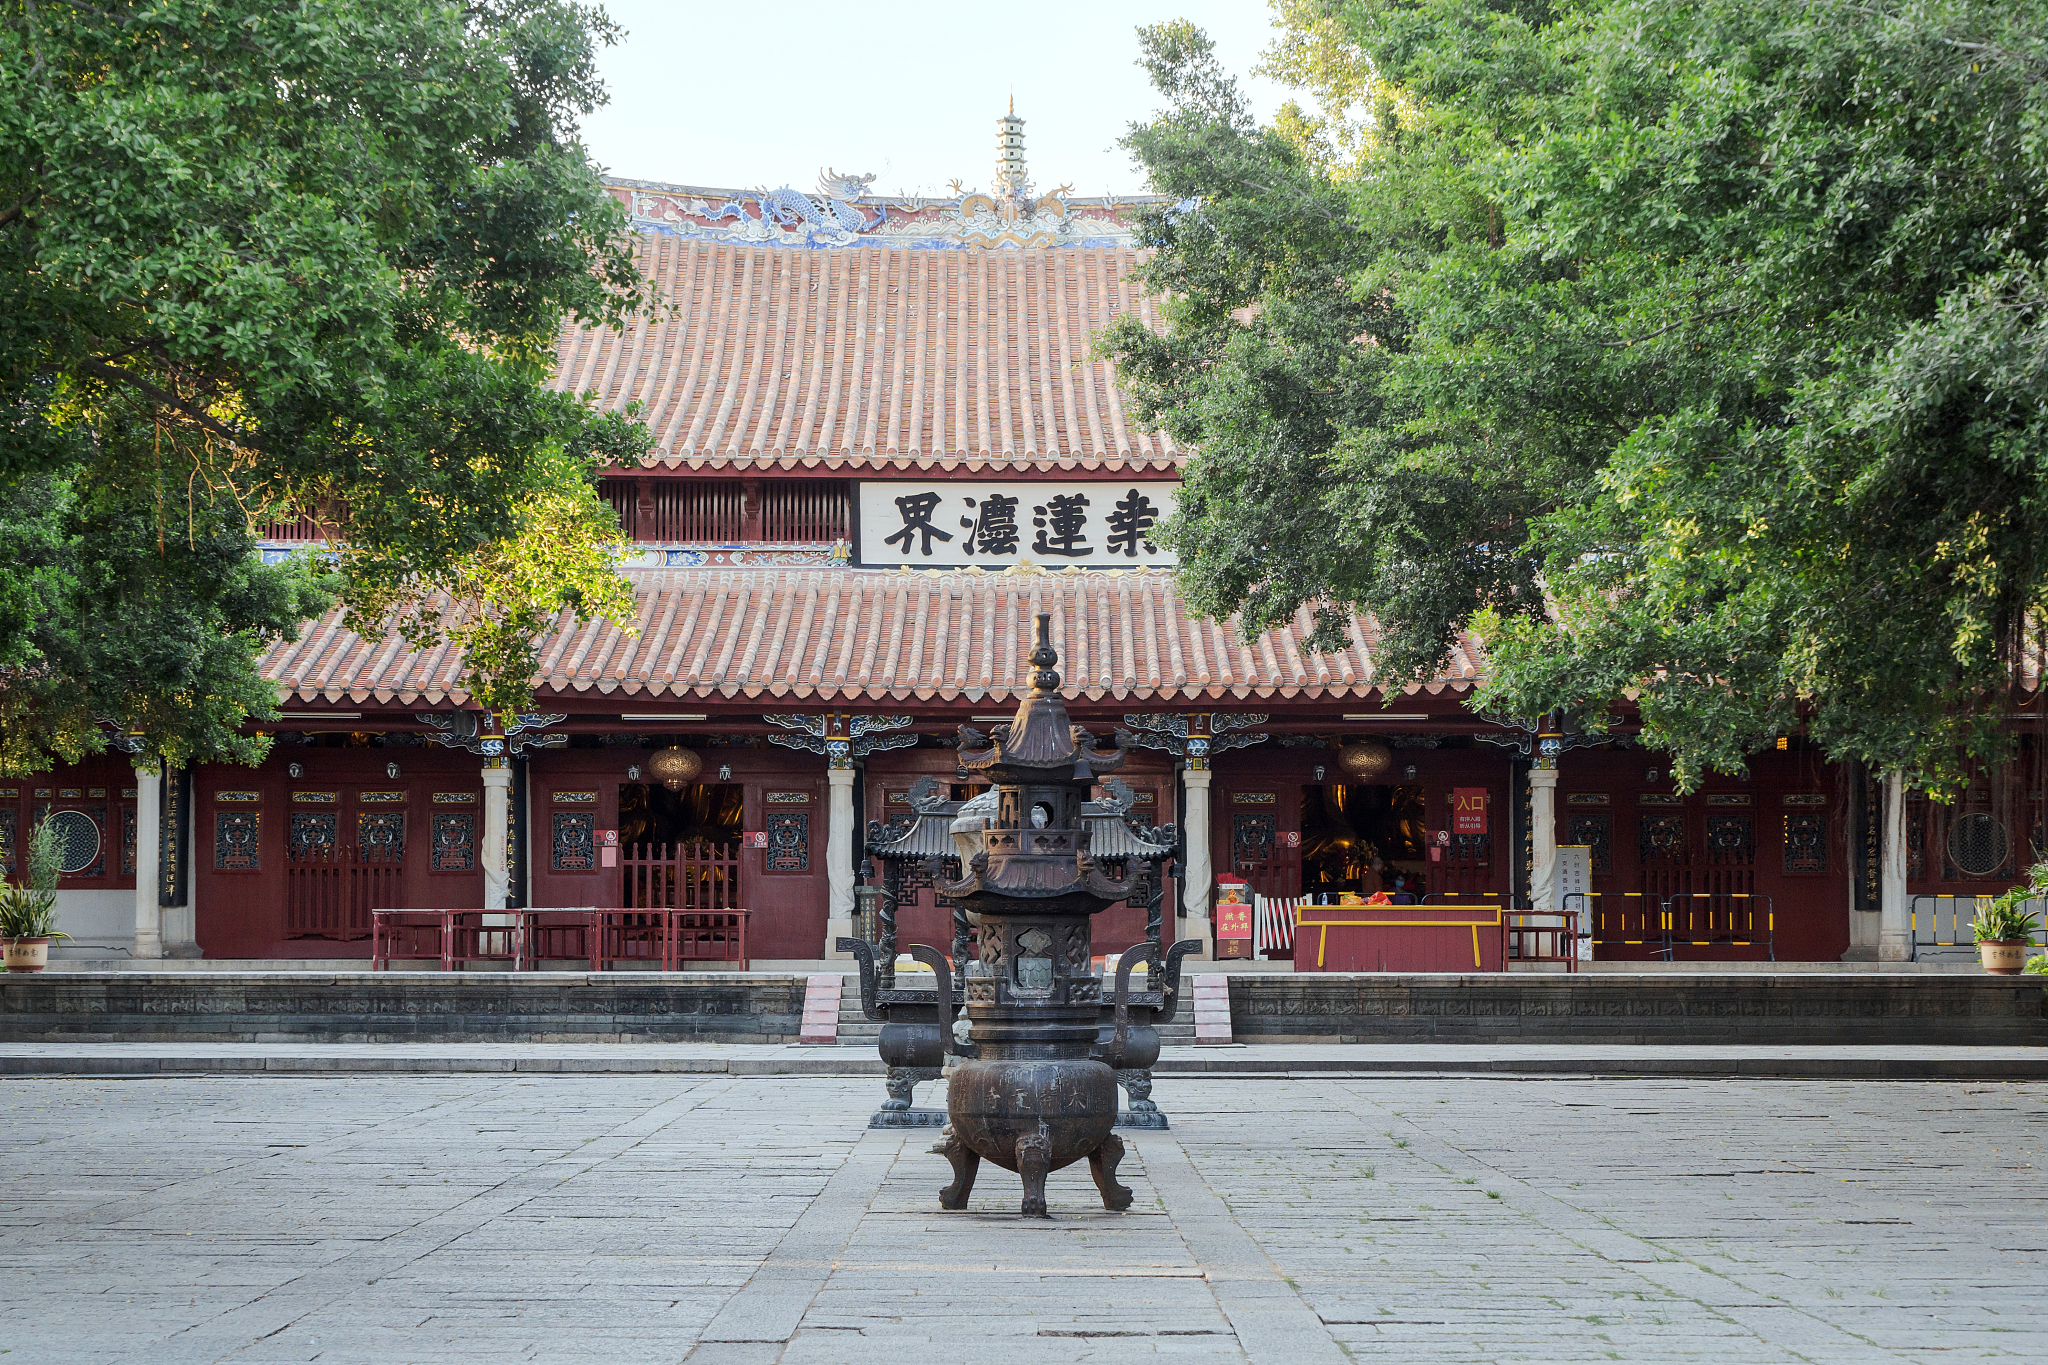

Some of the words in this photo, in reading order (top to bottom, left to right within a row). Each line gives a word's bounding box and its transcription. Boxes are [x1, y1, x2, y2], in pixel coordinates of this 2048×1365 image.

[1457, 795, 1484, 811] 入口
[1220, 922, 1249, 932] 在外拜
[1992, 950, 2022, 959] 吉祥如意
